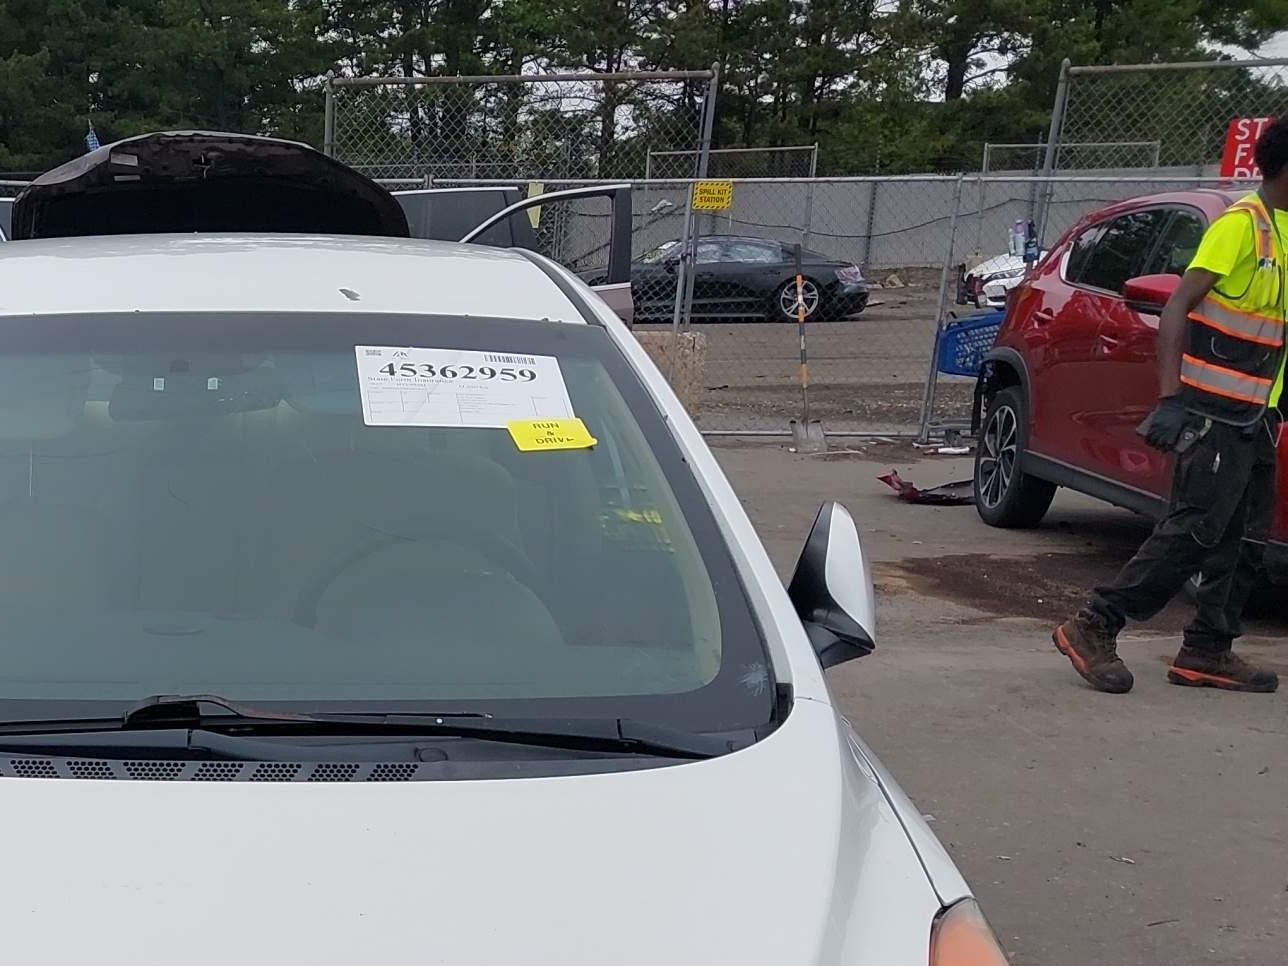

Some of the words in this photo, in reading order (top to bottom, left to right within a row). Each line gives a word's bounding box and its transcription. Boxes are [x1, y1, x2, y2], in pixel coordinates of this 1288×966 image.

[699, 188, 716, 196] SPILL
[379, 362, 537, 382] 45362959
[532, 422, 560, 430] RUN
